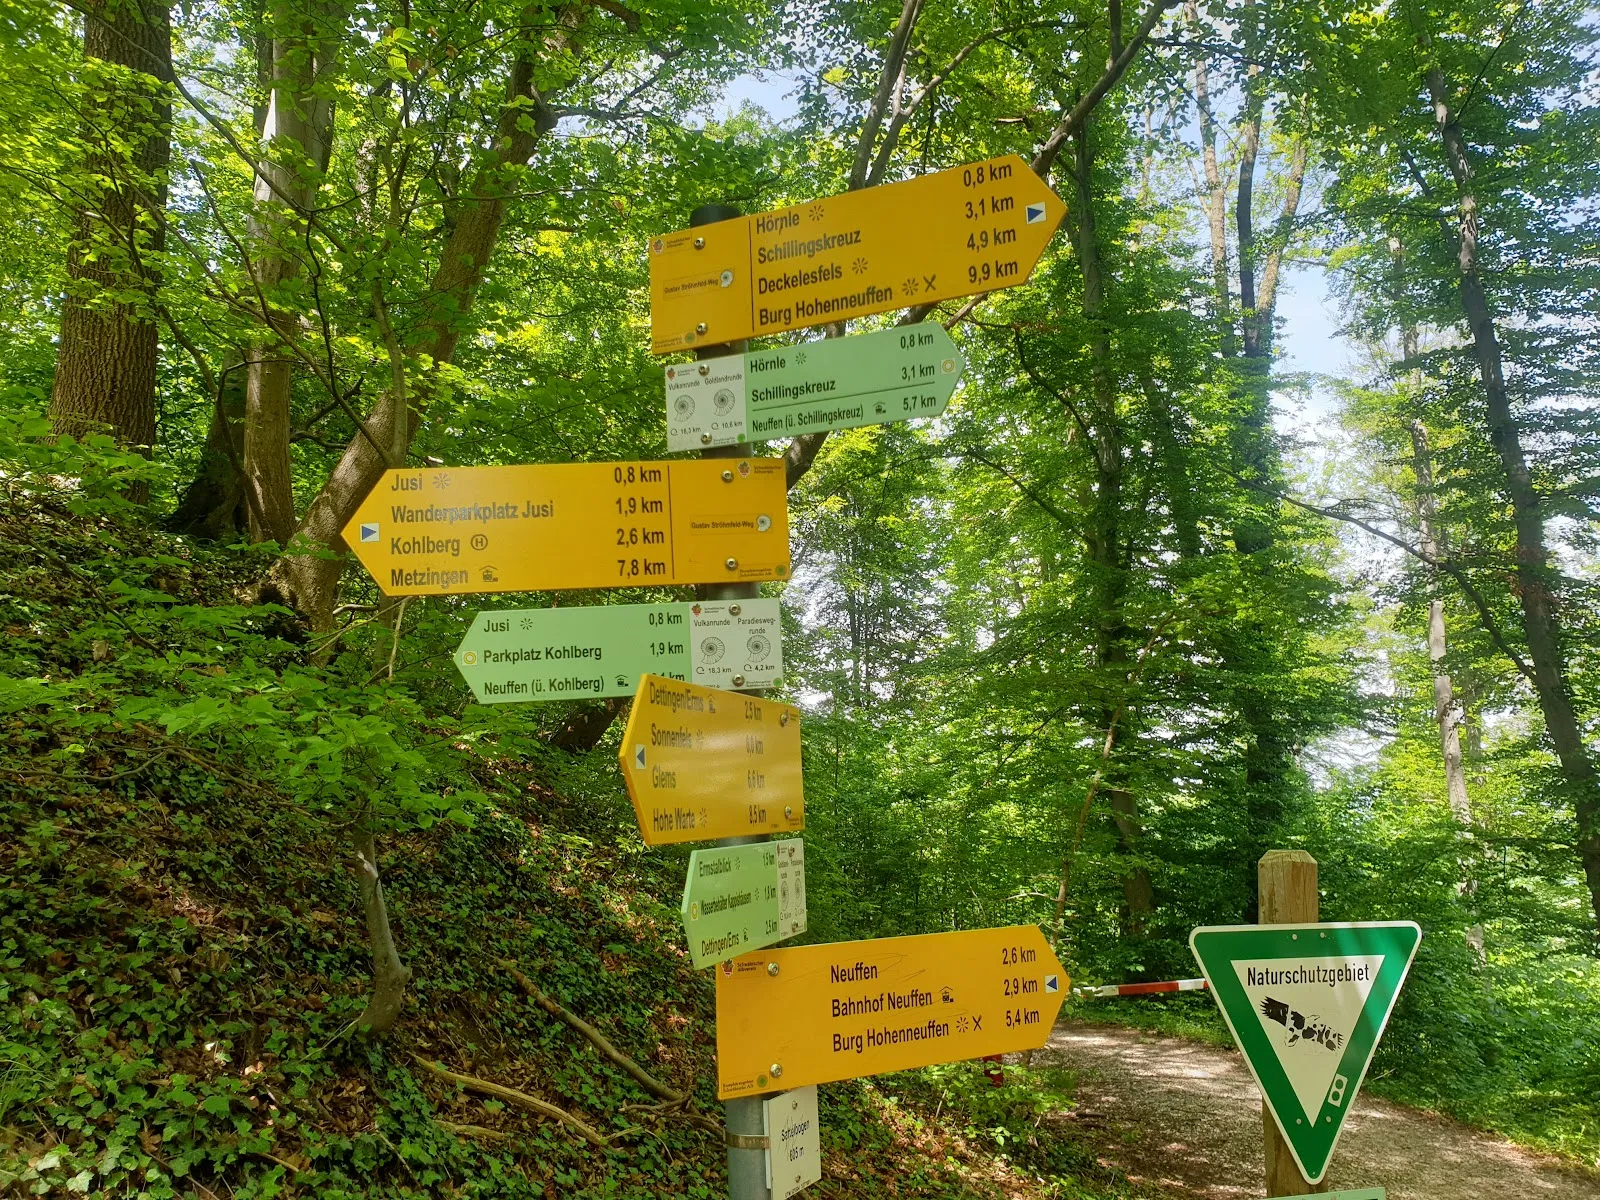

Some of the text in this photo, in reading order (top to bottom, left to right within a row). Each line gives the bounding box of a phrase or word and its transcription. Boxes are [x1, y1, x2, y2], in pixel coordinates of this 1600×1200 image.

[964, 163, 1012, 189] 0,8 km
[965, 195, 1014, 220] 3,1 km
[756, 211, 799, 234] Hörnle
[758, 229, 861, 264] Schillingskreuz
[966, 227, 1016, 252] 4,9 km
[759, 262, 842, 294] Deckelesfels
[969, 260, 1018, 284] 9,9 km
[759, 284, 892, 327] Burg Hohenneuffen
[900, 332, 934, 350] 0,8 km
[750, 356, 786, 373] Hörnle
[902, 363, 935, 381] 3,1 km
[752, 380, 836, 402] Schillingskreuz
[903, 395, 936, 412] 5,7 km
[752, 405, 864, 432] Neuffen (ü. Schillingskreuz)
[391, 474, 422, 493] Jusi
[614, 466, 662, 487] 0,8 km
[392, 500, 554, 530] Wanderparkplatz Jusi
[616, 498, 663, 517] 1,9 km
[391, 536, 461, 557] Kohlberg
[616, 528, 664, 548] 2,6 km
[391, 568, 468, 590] Metzingen
[618, 559, 666, 579] 7,8 km
[484, 619, 510, 632] Jusi
[649, 612, 682, 626] 0,8 km
[694, 619, 730, 627] Vulkanrunde
[484, 645, 602, 664] Parkplatz Kohlberg
[650, 642, 683, 656] 1,9 km
[484, 677, 604, 696] Neuffen (ü. Kohlberg)
[650, 682, 704, 713] Dettingen/Erms
[754, 703, 762, 720] km
[756, 736, 763, 754] km
[652, 765, 676, 789] Glems
[756, 771, 764, 788] km
[654, 808, 695, 831] Hohe Warte
[758, 806, 766, 823] km
[1002, 947, 1036, 965] 2,6 km
[830, 964, 878, 983] Neuffen
[1248, 964, 1369, 987] Naturschutzgebiet
[1004, 978, 1038, 996] 2,9 km
[832, 990, 932, 1018] Bahnhof Neuffen
[1006, 1009, 1040, 1027] 5,4 km
[833, 1021, 949, 1053] Burg Hohenneuffen
